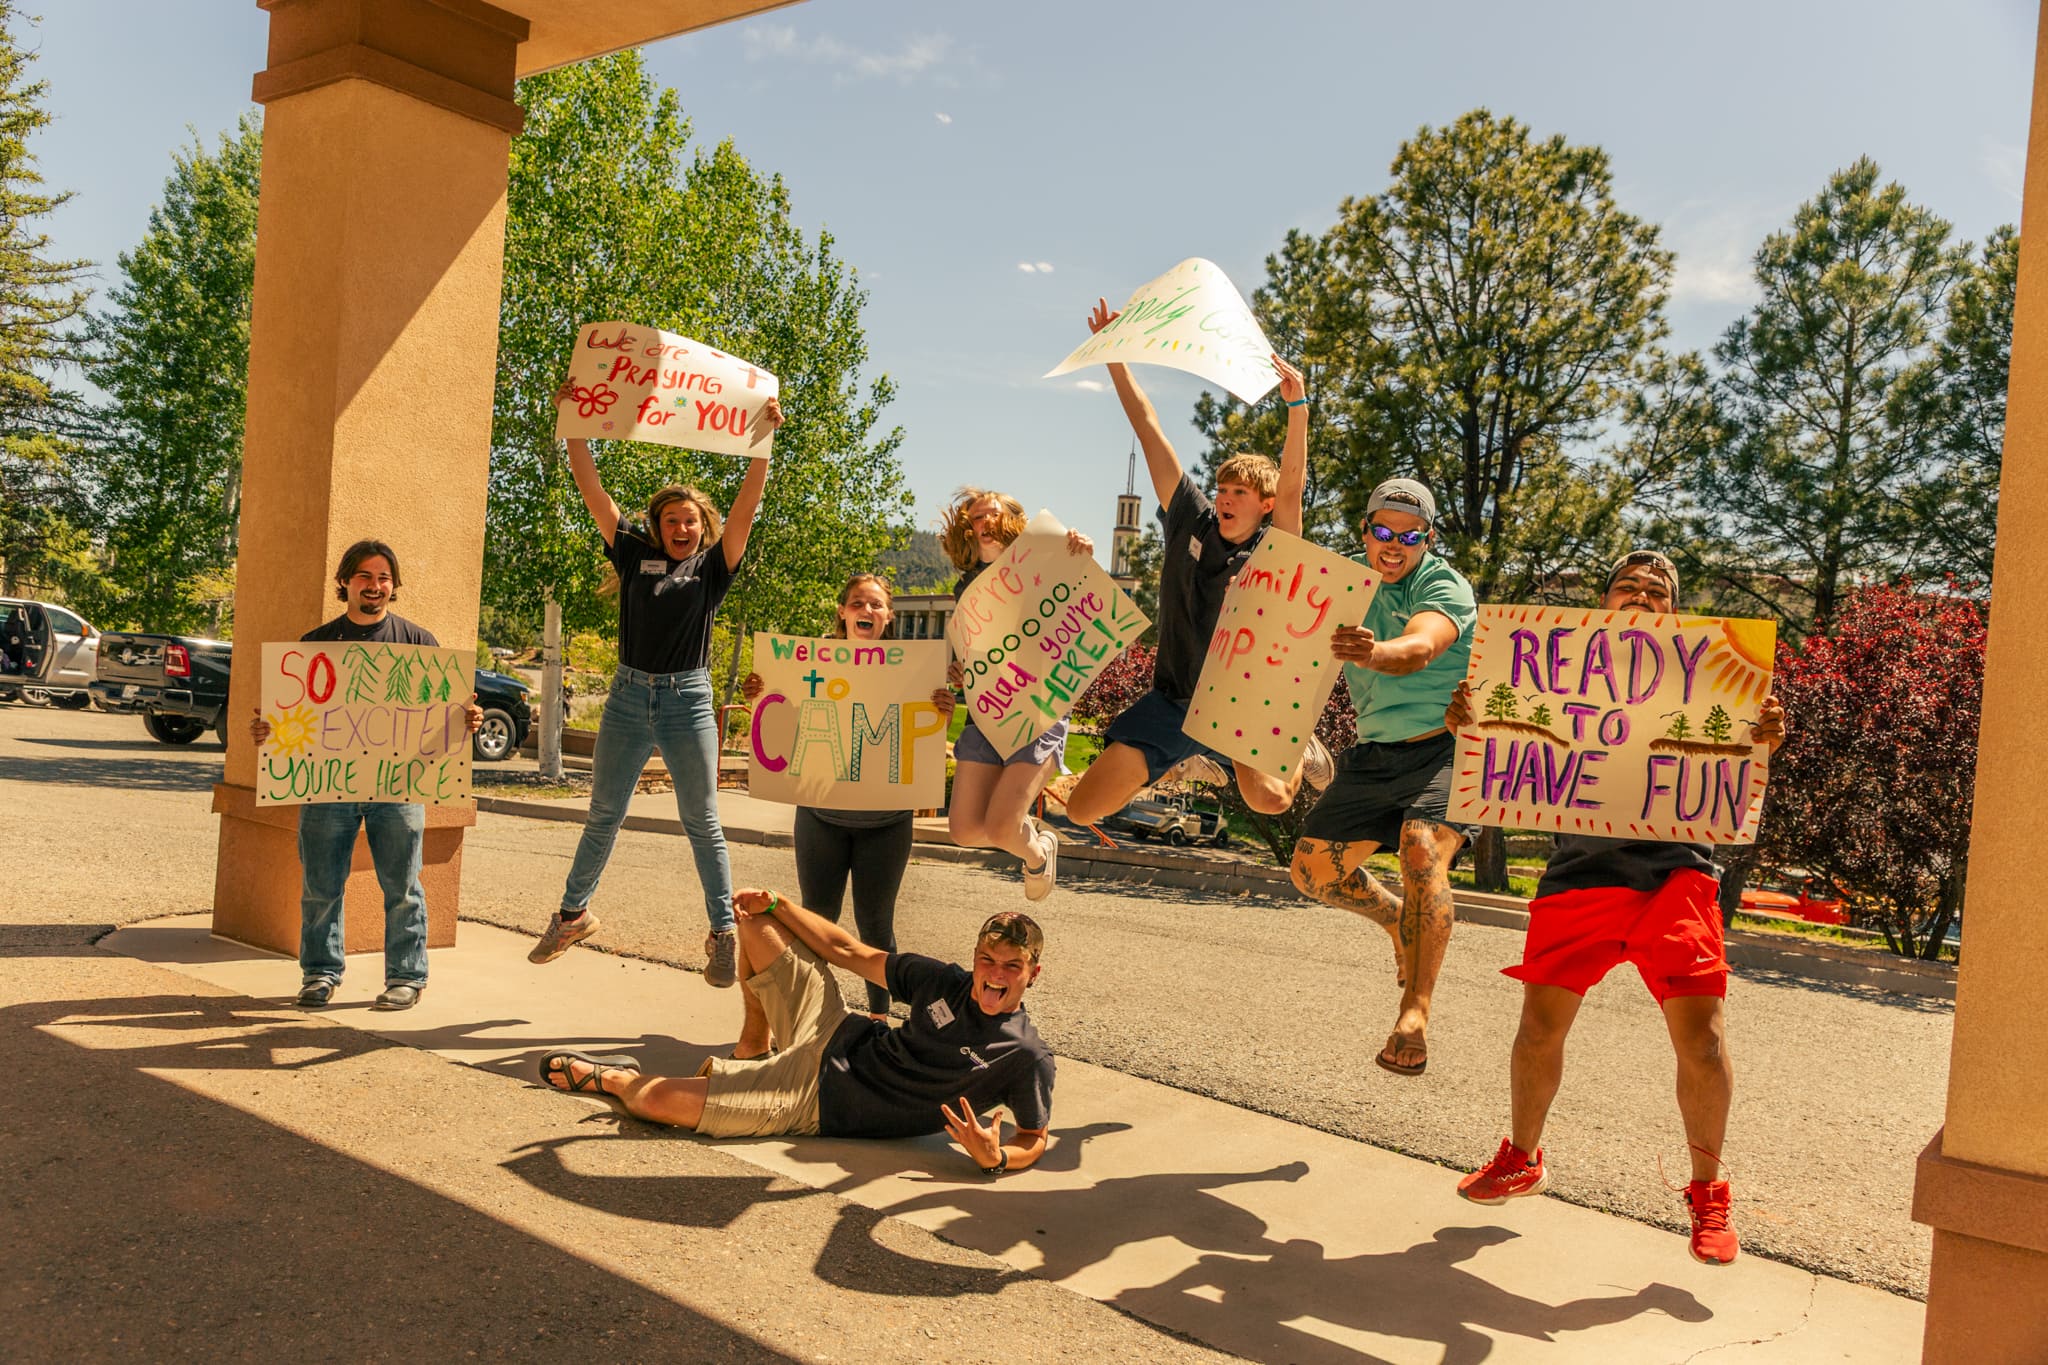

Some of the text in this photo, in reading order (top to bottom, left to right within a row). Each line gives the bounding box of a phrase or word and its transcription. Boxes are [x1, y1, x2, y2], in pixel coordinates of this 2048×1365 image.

[644, 342, 690, 361] are
[637, 395, 748, 437] for YOU
[1040, 592, 1104, 660] you're
[1239, 563, 1334, 639] amily
[275, 650, 337, 710] SO
[771, 637, 904, 666] Welcome
[1031, 618, 1124, 719] HERE!
[1510, 627, 1711, 706] READY
[802, 669, 850, 701] to
[321, 702, 469, 756] EXCITED
[751, 693, 947, 785] CAMP
[1562, 702, 1631, 747] TO
[268, 757, 452, 800] YOU'RE HERE
[1481, 736, 1751, 831] HAVE FUN
